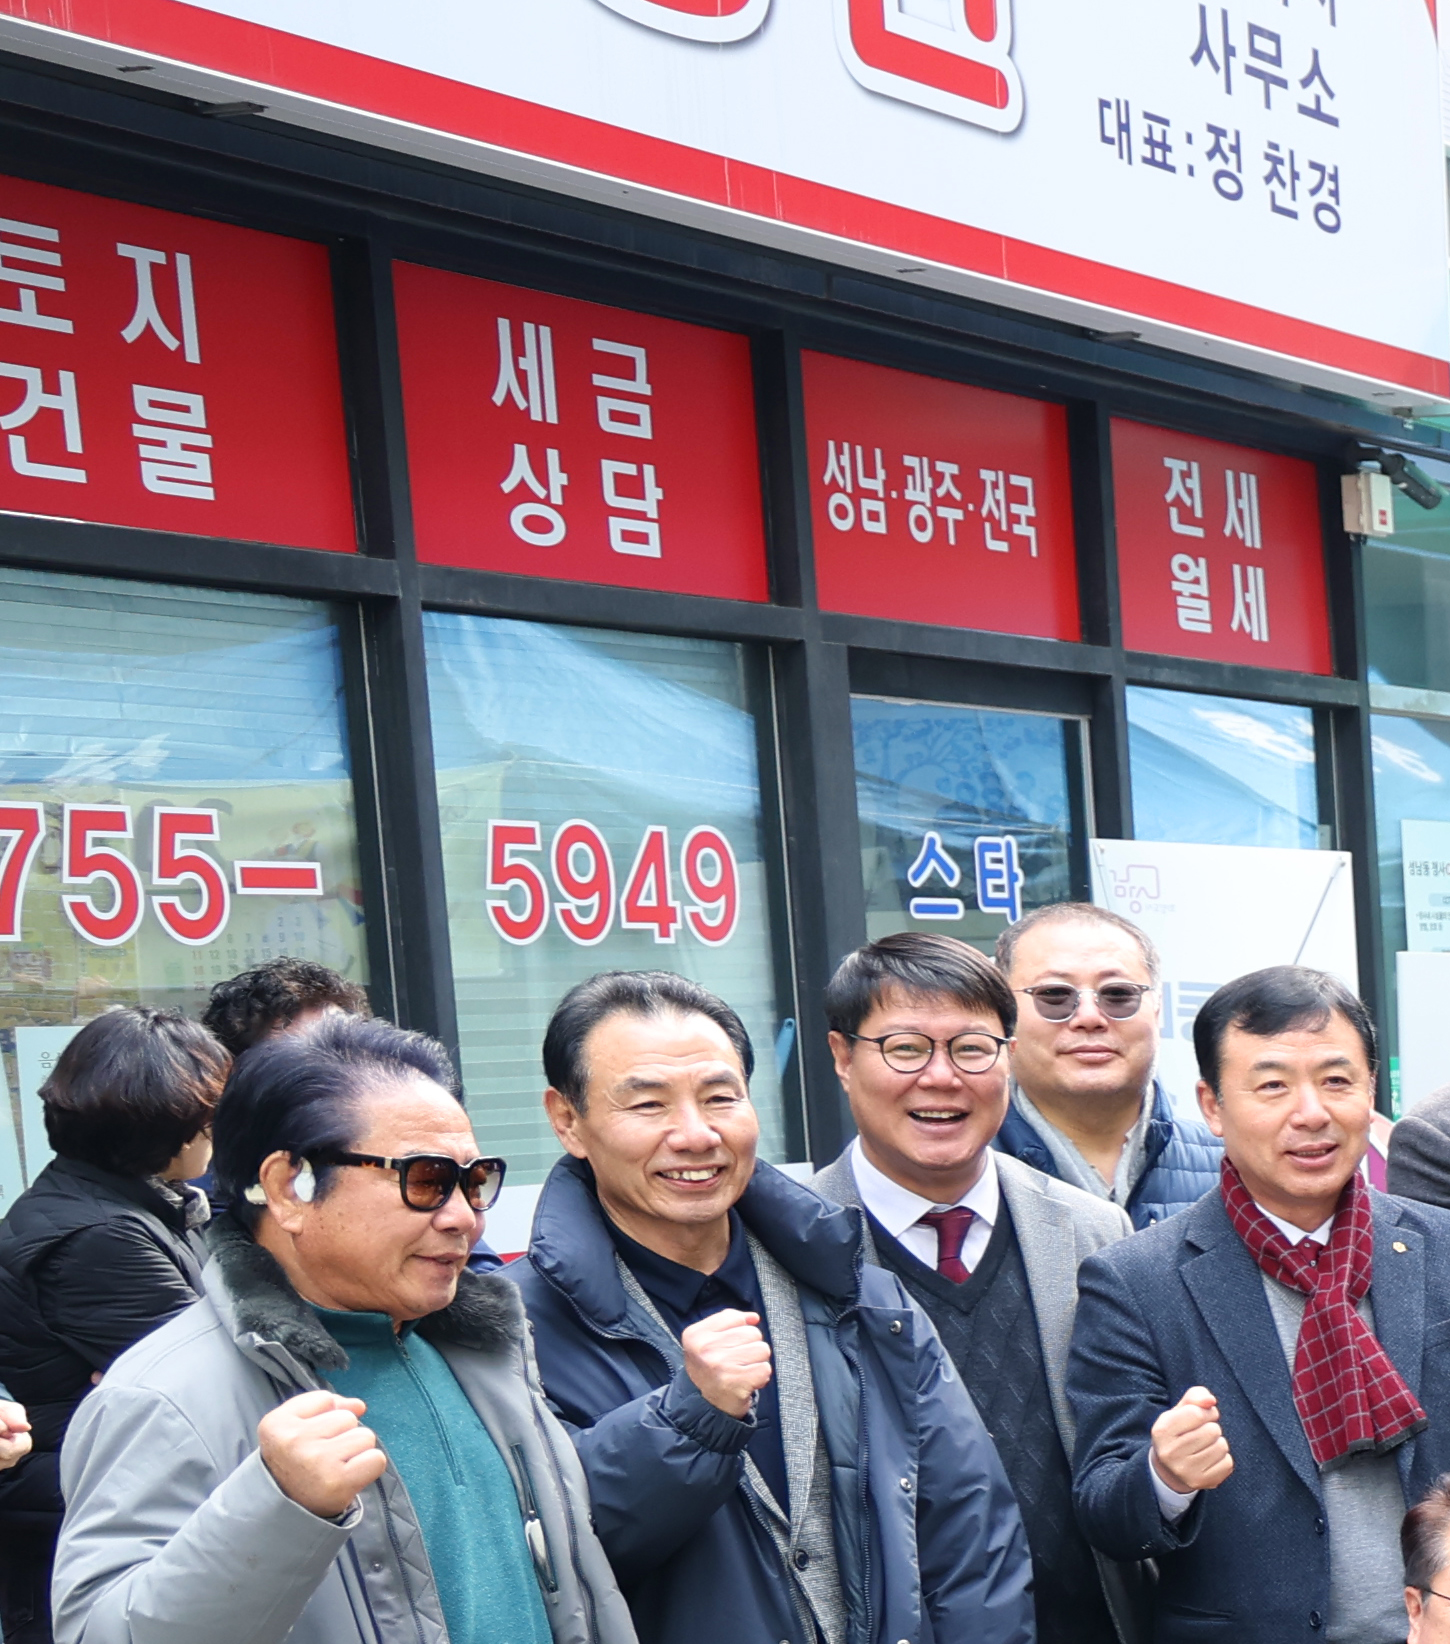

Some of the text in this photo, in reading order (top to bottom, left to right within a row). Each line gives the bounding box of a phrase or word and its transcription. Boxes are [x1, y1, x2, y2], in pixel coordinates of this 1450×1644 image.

[1189, 10, 1341, 130] 사무소
[0, 362, 215, 500] 건물
[491, 317, 653, 440] 세금
[500, 443, 663, 559] 상담
[1164, 456, 1263, 550] 전세
[1170, 552, 1269, 643] 월세
[486, 819, 740, 947] 5949
[1408, 860, 1430, 876] 성남동
